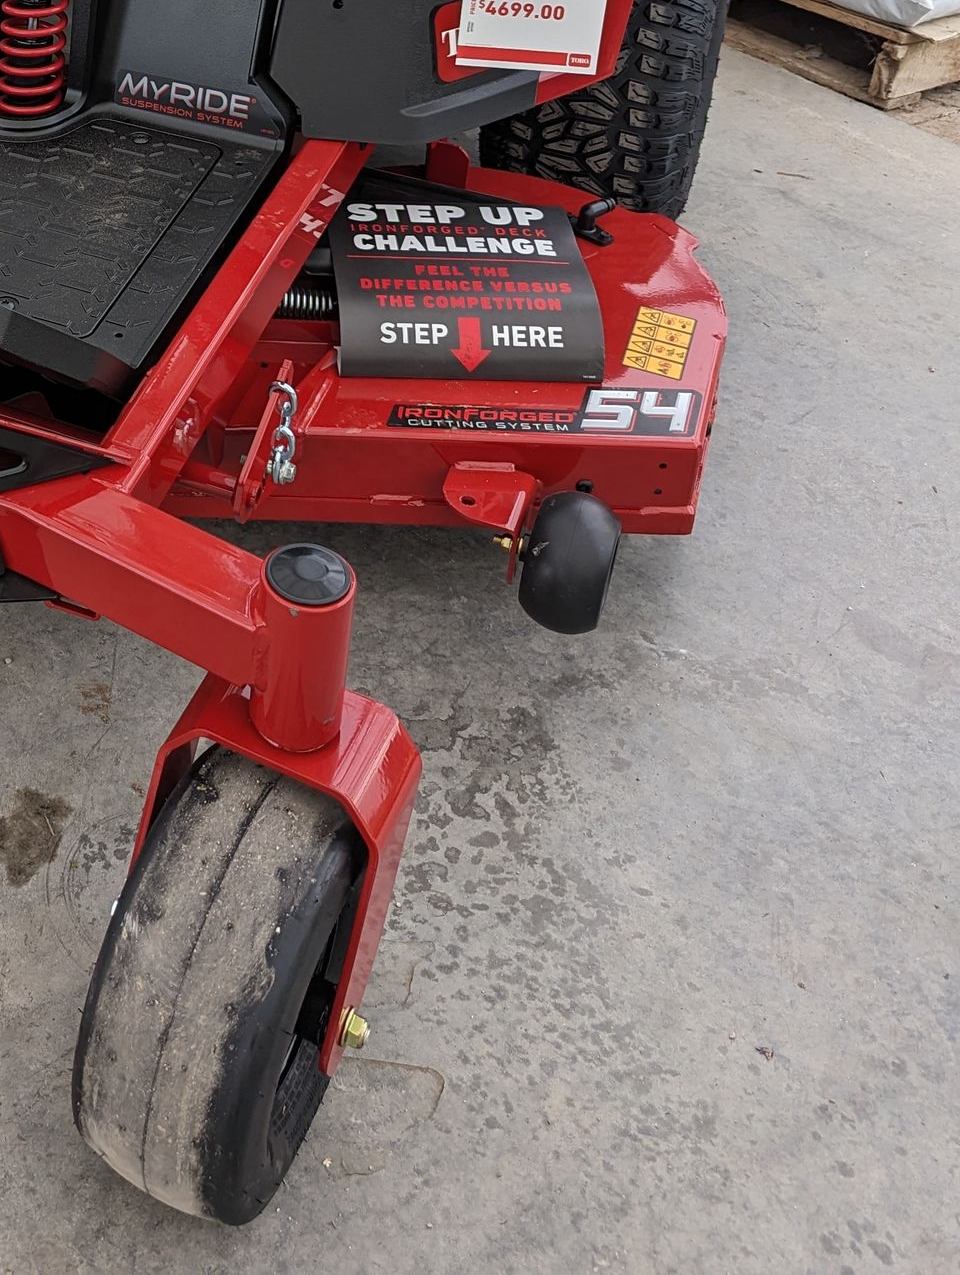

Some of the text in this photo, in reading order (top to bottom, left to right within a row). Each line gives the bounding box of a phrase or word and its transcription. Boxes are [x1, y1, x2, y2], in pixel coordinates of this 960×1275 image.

[478, 0, 565, 21] $4699.00
[122, 96, 243, 129] SUSPENSION SYSTEM
[346, 203, 544, 226] STEP UP
[495, 227, 548, 238] DECK
[353, 234, 558, 257] CHALLENGE
[415, 265, 510, 278] FEEL THE
[360, 278, 573, 294] DIFFERENCE VERSUS
[375, 294, 563, 311] THE COMPETITION
[380, 321, 449, 346] STEP
[492, 325, 565, 348] HERE
[397, 389, 694, 433] IRONFORGED 54
[407, 418, 570, 432] CUTTING SYSTEM
